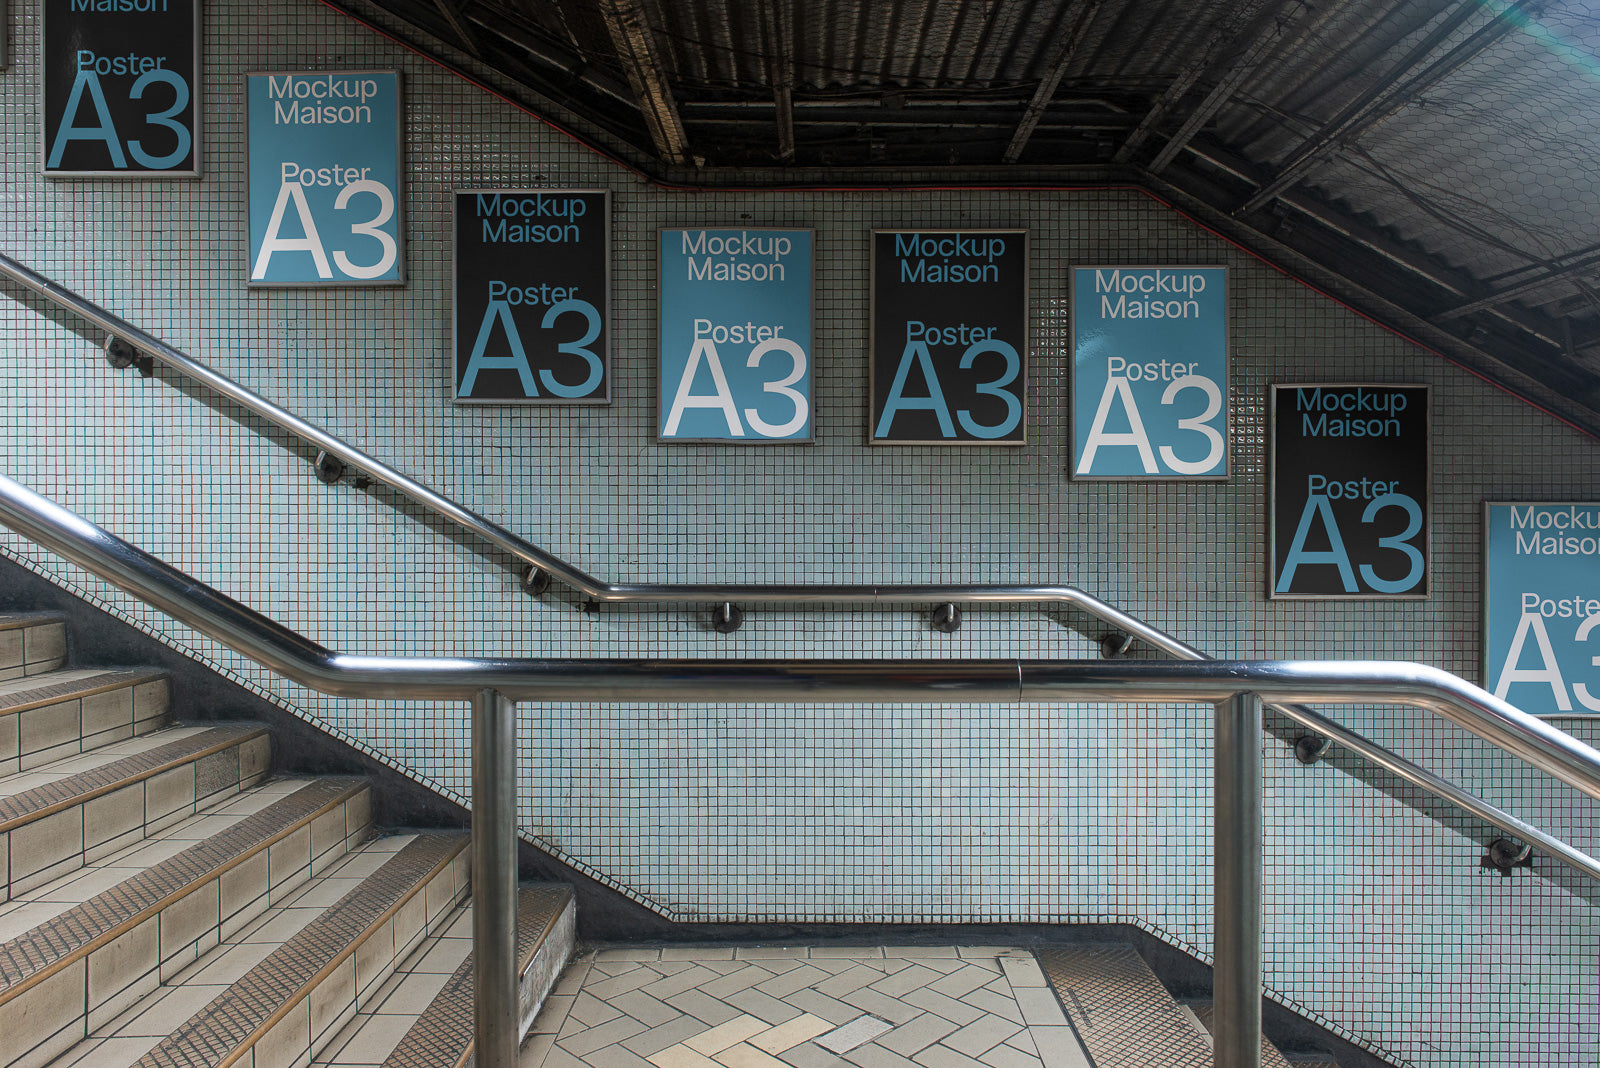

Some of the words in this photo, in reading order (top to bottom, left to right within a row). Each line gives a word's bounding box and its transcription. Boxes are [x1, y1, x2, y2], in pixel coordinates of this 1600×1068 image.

[77, 50, 166, 75] Poster
[268, 75, 377, 103] Mockup
[46, 69, 191, 169] A3
[275, 100, 371, 124] Maison
[281, 162, 371, 186] Poster
[476, 193, 586, 223] Mockup
[251, 180, 397, 279] A3
[482, 218, 580, 243] Maison
[682, 231, 791, 261] Mockup
[895, 233, 1006, 263] Mockup
[688, 257, 785, 281] Maison
[901, 259, 999, 283] Maison
[488, 281, 578, 305] Poster
[1095, 269, 1206, 298] Mockup
[1101, 295, 1199, 319] Maison
[694, 319, 783, 344] Poster
[906, 321, 997, 345] Poster
[457, 299, 604, 398] A3
[1107, 357, 1198, 381] Poster
[662, 337, 809, 437] A3
[874, 339, 1022, 439] A3
[1296, 387, 1407, 417] Mockup
[1076, 375, 1225, 475] A3
[1302, 413, 1400, 437] Maison
[1308, 475, 1399, 500] Poster
[1510, 506, 1600, 529] Mocku
[1275, 493, 1425, 593] A3
[1516, 531, 1600, 555] Maiso
[1521, 593, 1600, 618] Poste
